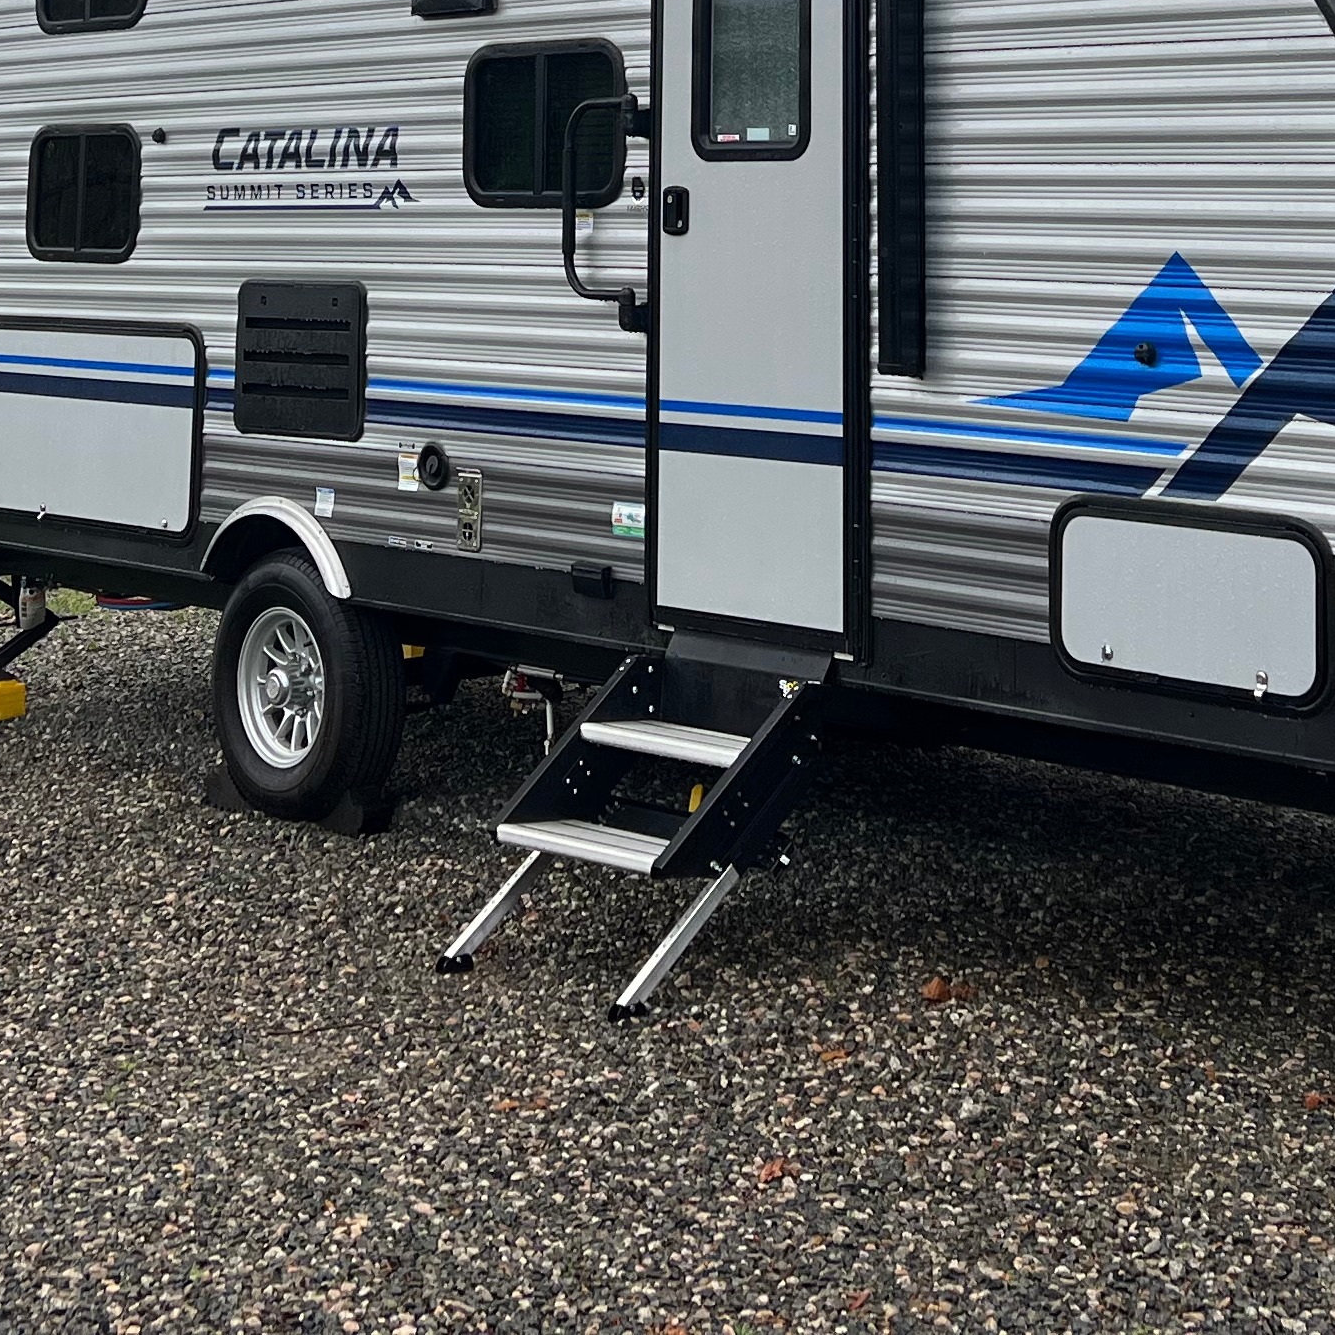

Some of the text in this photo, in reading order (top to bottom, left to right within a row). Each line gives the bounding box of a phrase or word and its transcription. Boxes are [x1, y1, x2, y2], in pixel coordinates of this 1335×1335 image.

[211, 125, 400, 170] CATALINA
[206, 182, 373, 200] SUMMIT SERIES
